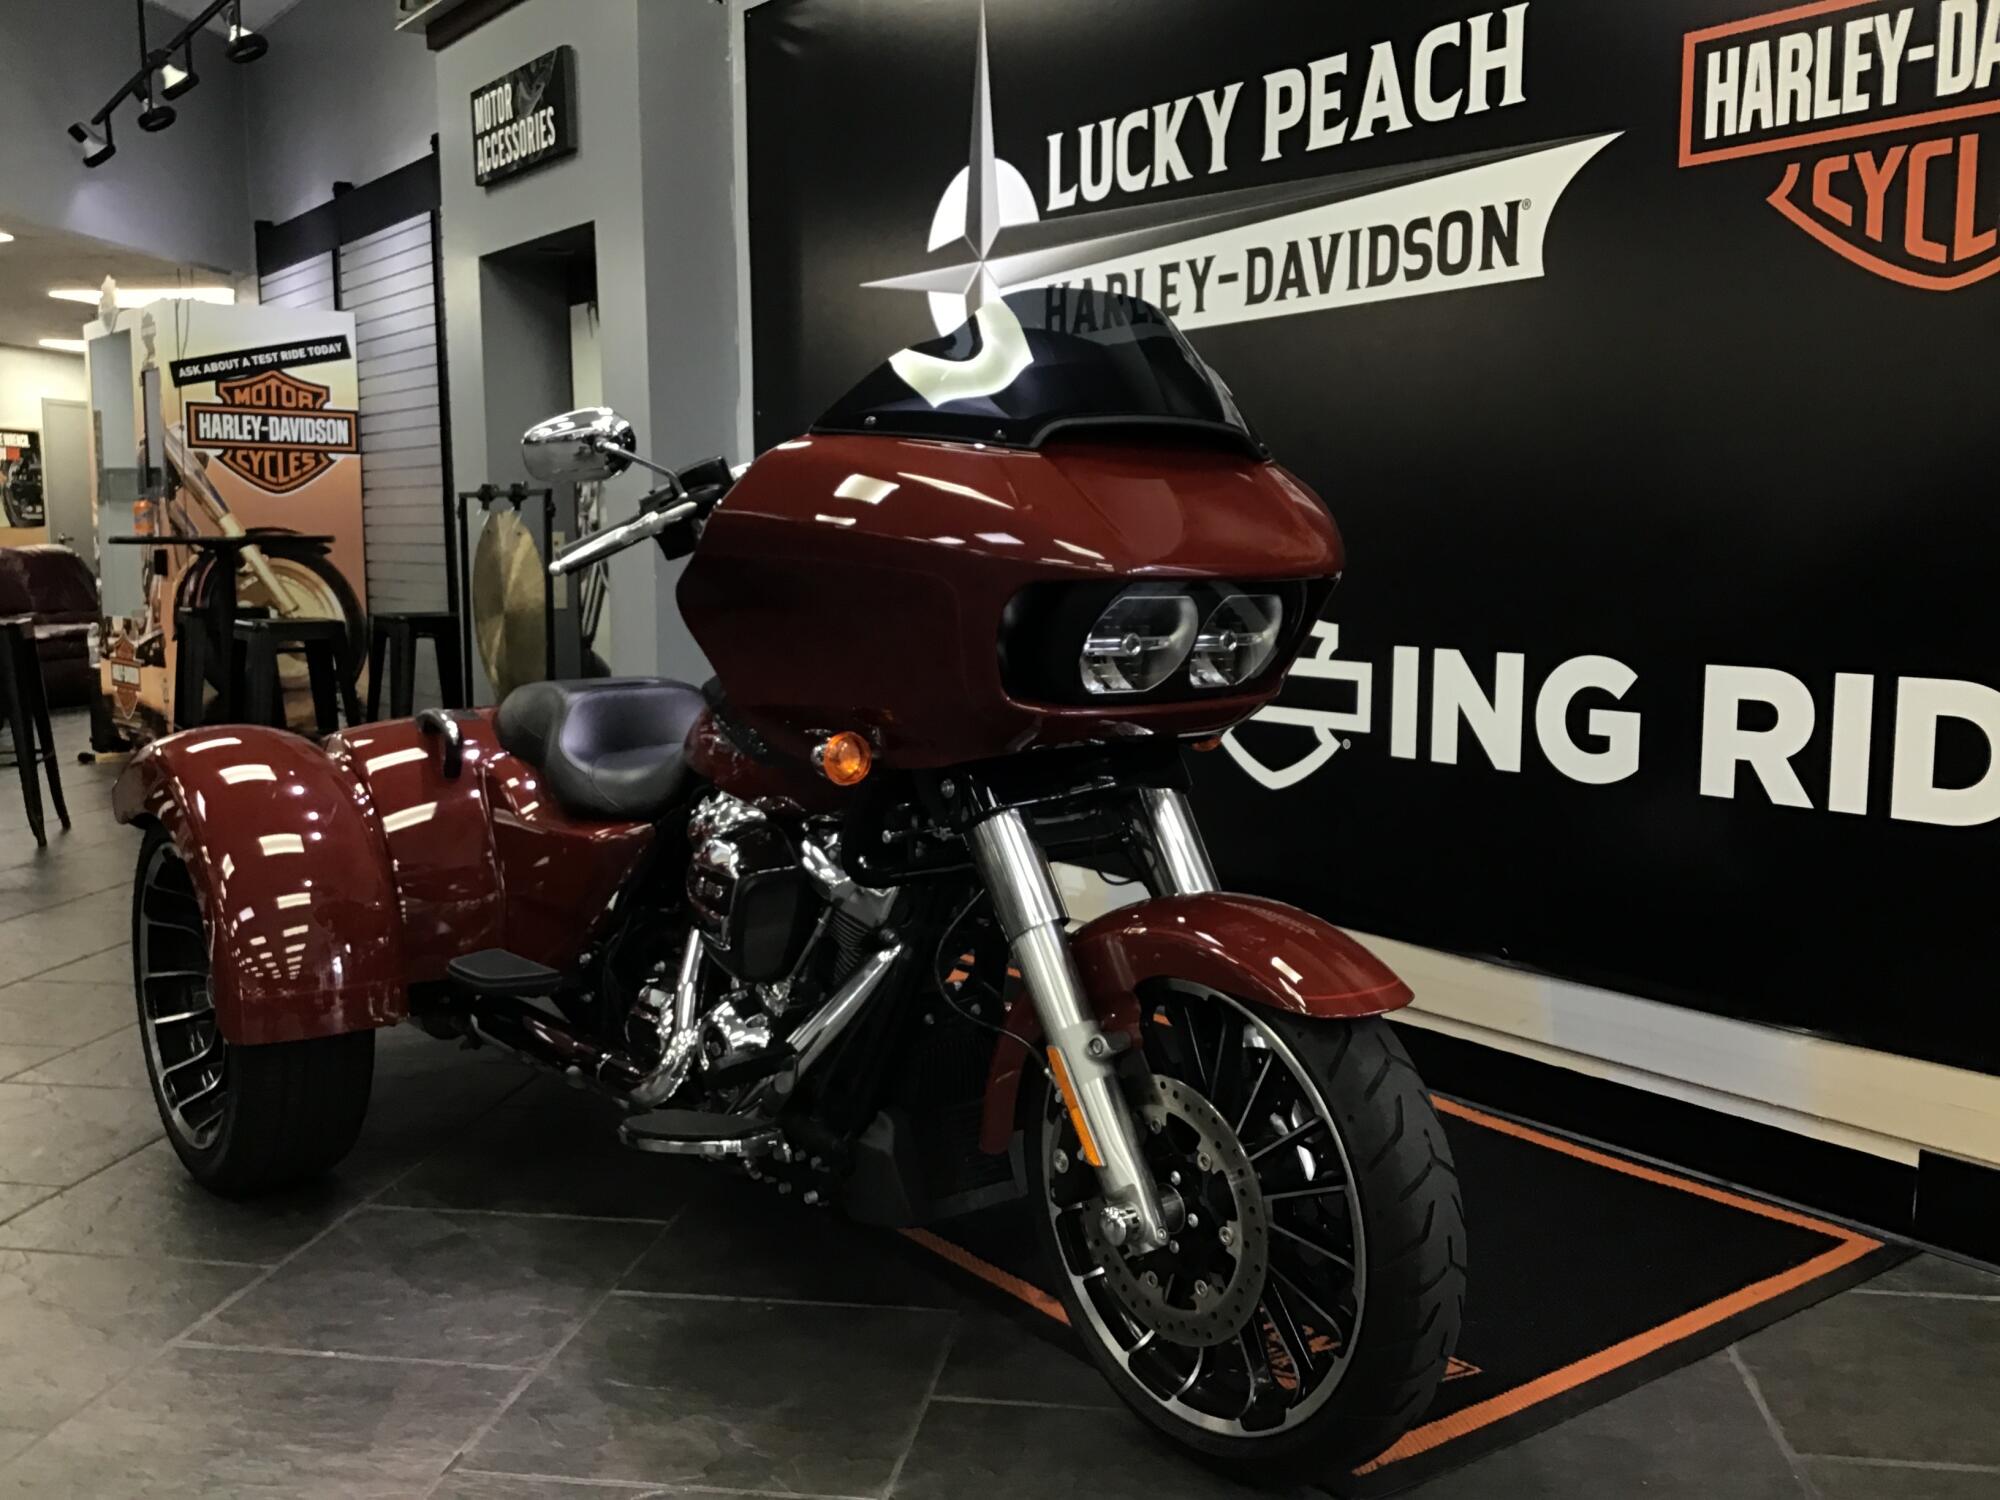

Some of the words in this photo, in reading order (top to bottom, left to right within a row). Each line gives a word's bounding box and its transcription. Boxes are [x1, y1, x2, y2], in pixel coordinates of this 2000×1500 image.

[474, 83, 514, 134] MOTOR
[1046, 82, 1244, 211] LUCKY
[1261, 2, 1529, 161] PEACH
[477, 106, 556, 175] ACCESSORIES
[179, 364, 202, 378] ASK
[203, 358, 240, 373] ABOUT
[242, 356, 251, 367] A
[251, 350, 279, 365] TEST
[280, 346, 306, 362] RIDE
[306, 342, 342, 357] TODAY
[233, 376, 314, 409] MOTOR
[198, 412, 349, 445] HARLEY-DAVIDSON
[236, 451, 316, 483] CYCLES
[1391, 645, 1641, 785] ING
[1700, 664, 2000, 826] RID
